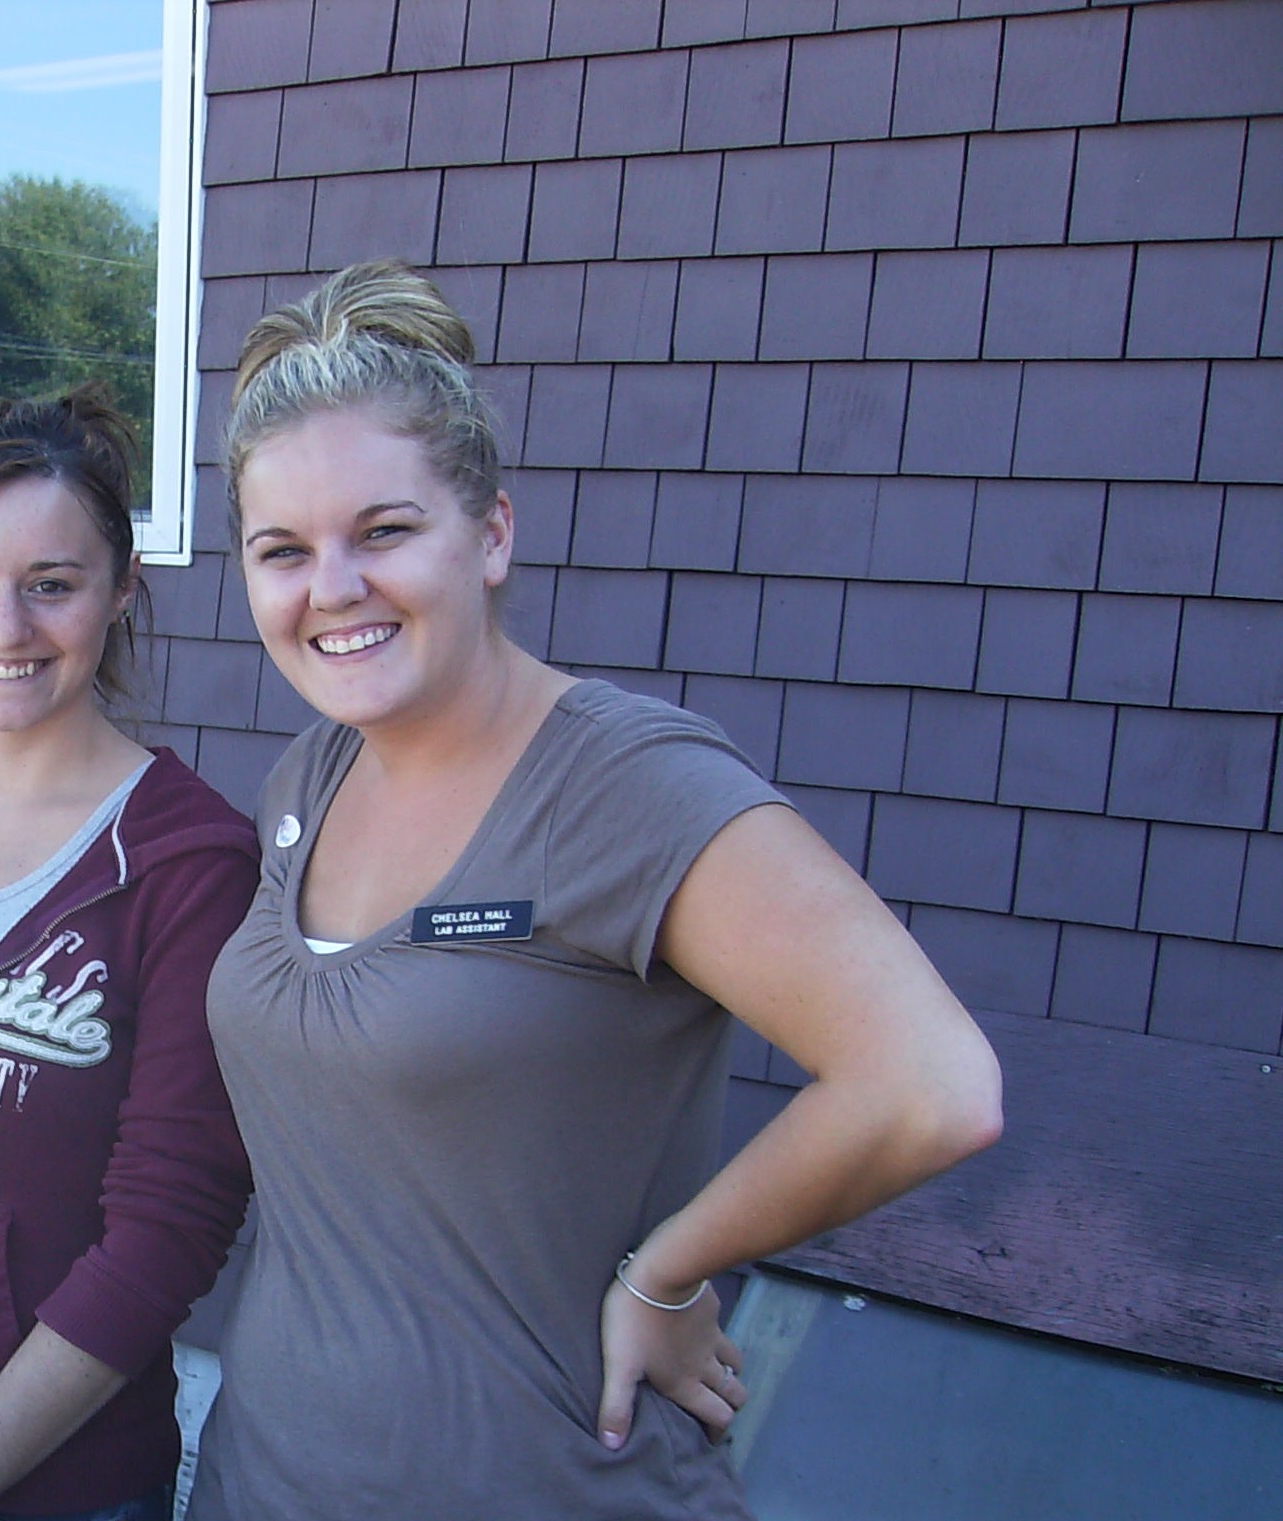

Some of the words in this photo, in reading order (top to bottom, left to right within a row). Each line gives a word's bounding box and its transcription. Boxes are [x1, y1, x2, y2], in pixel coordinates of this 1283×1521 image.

[431, 911, 479, 924] CHELSEA
[484, 909, 513, 920] HALL
[434, 926, 453, 936] LAB
[456, 922, 507, 934] ASSISTANT
